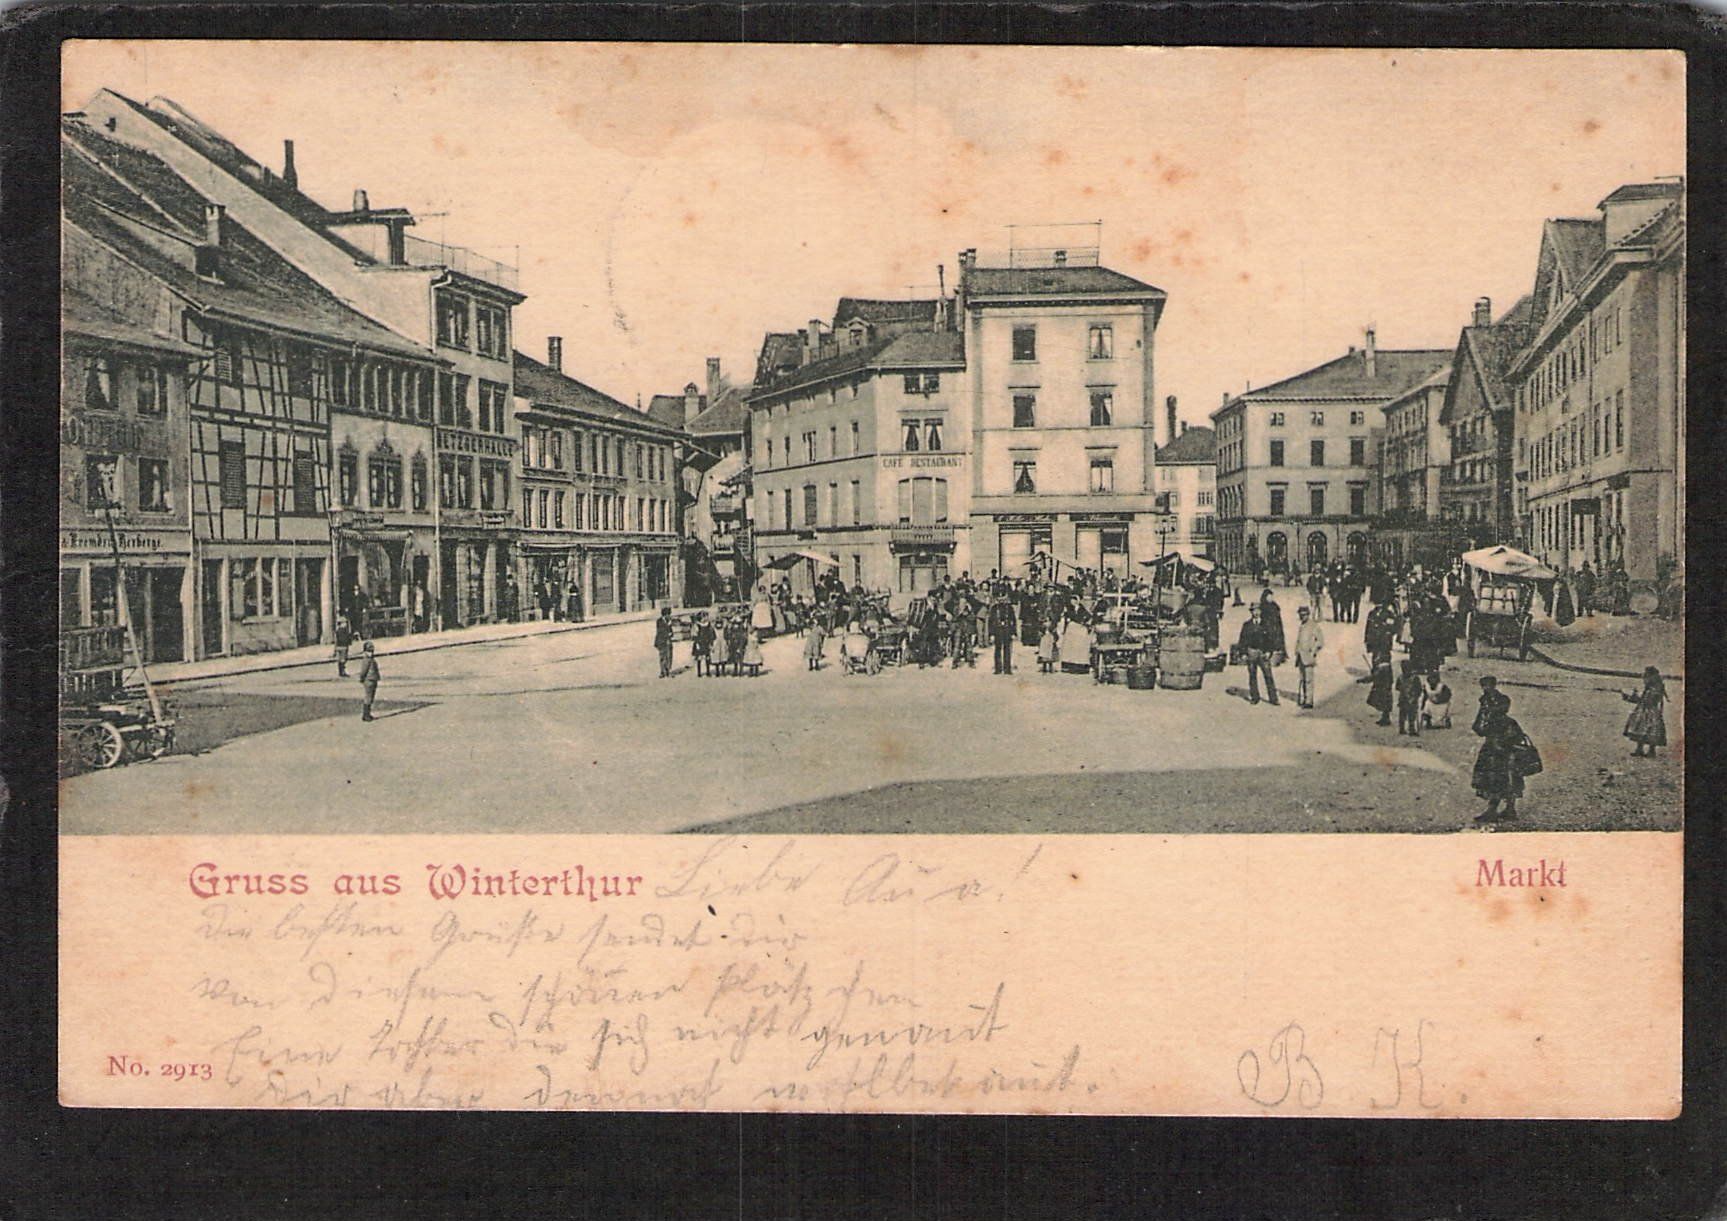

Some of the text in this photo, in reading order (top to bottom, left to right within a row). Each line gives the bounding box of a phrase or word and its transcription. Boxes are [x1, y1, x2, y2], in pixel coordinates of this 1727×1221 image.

[189, 863, 642, 902] Gruss aus Winterthur
[1476, 859, 1566, 889] Markt
[107, 1055, 213, 1081] No. 2913
